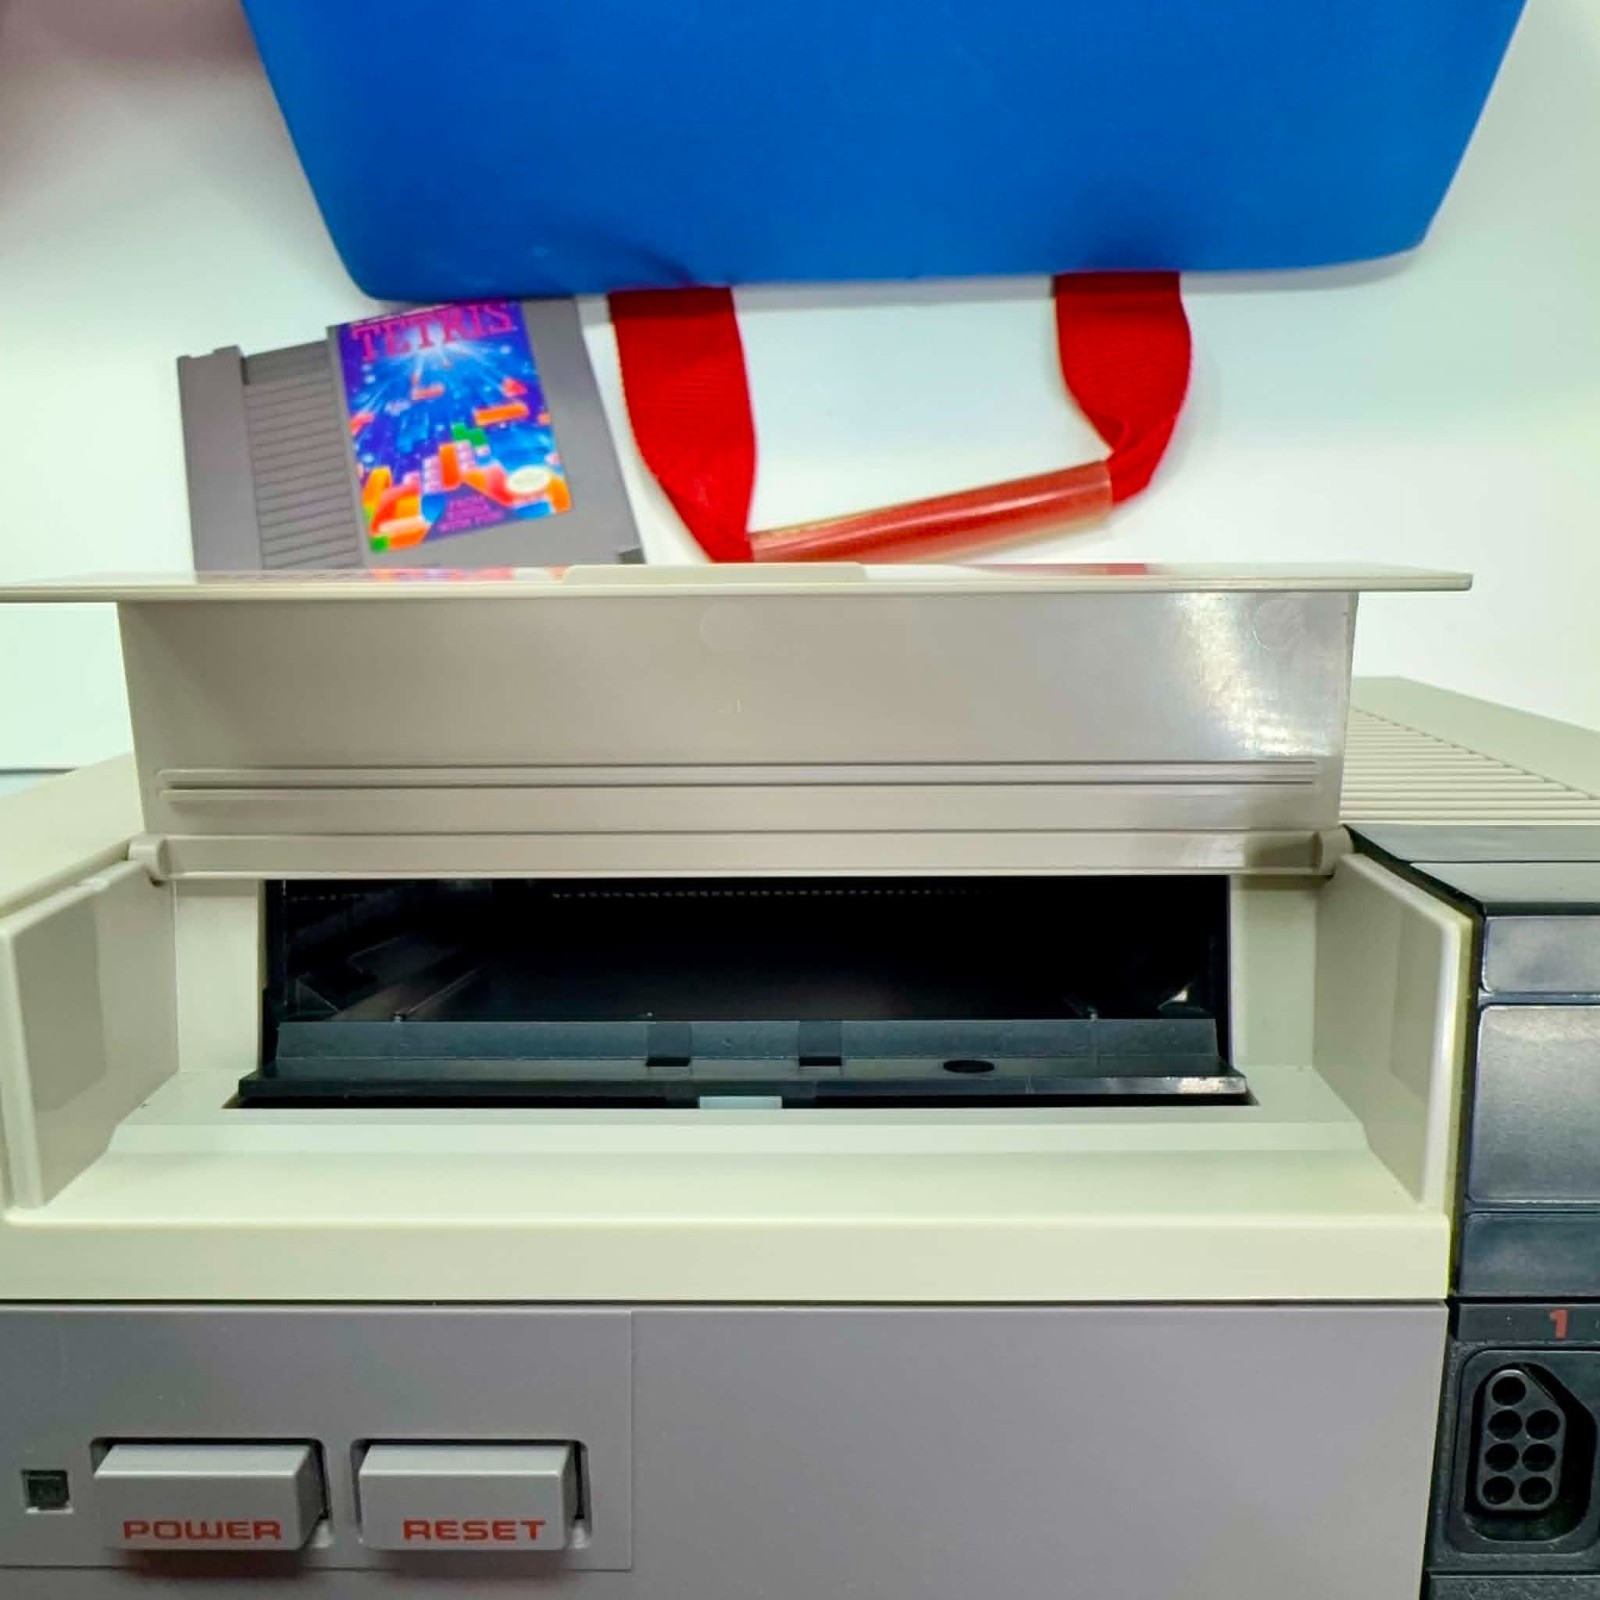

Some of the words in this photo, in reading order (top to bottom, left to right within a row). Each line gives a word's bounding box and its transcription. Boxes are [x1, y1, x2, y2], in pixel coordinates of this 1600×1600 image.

[352, 303, 513, 361] TETRIS
[1549, 1309, 1568, 1339] 1
[123, 1519, 281, 1541] POWER
[403, 1519, 546, 1541] RESET
